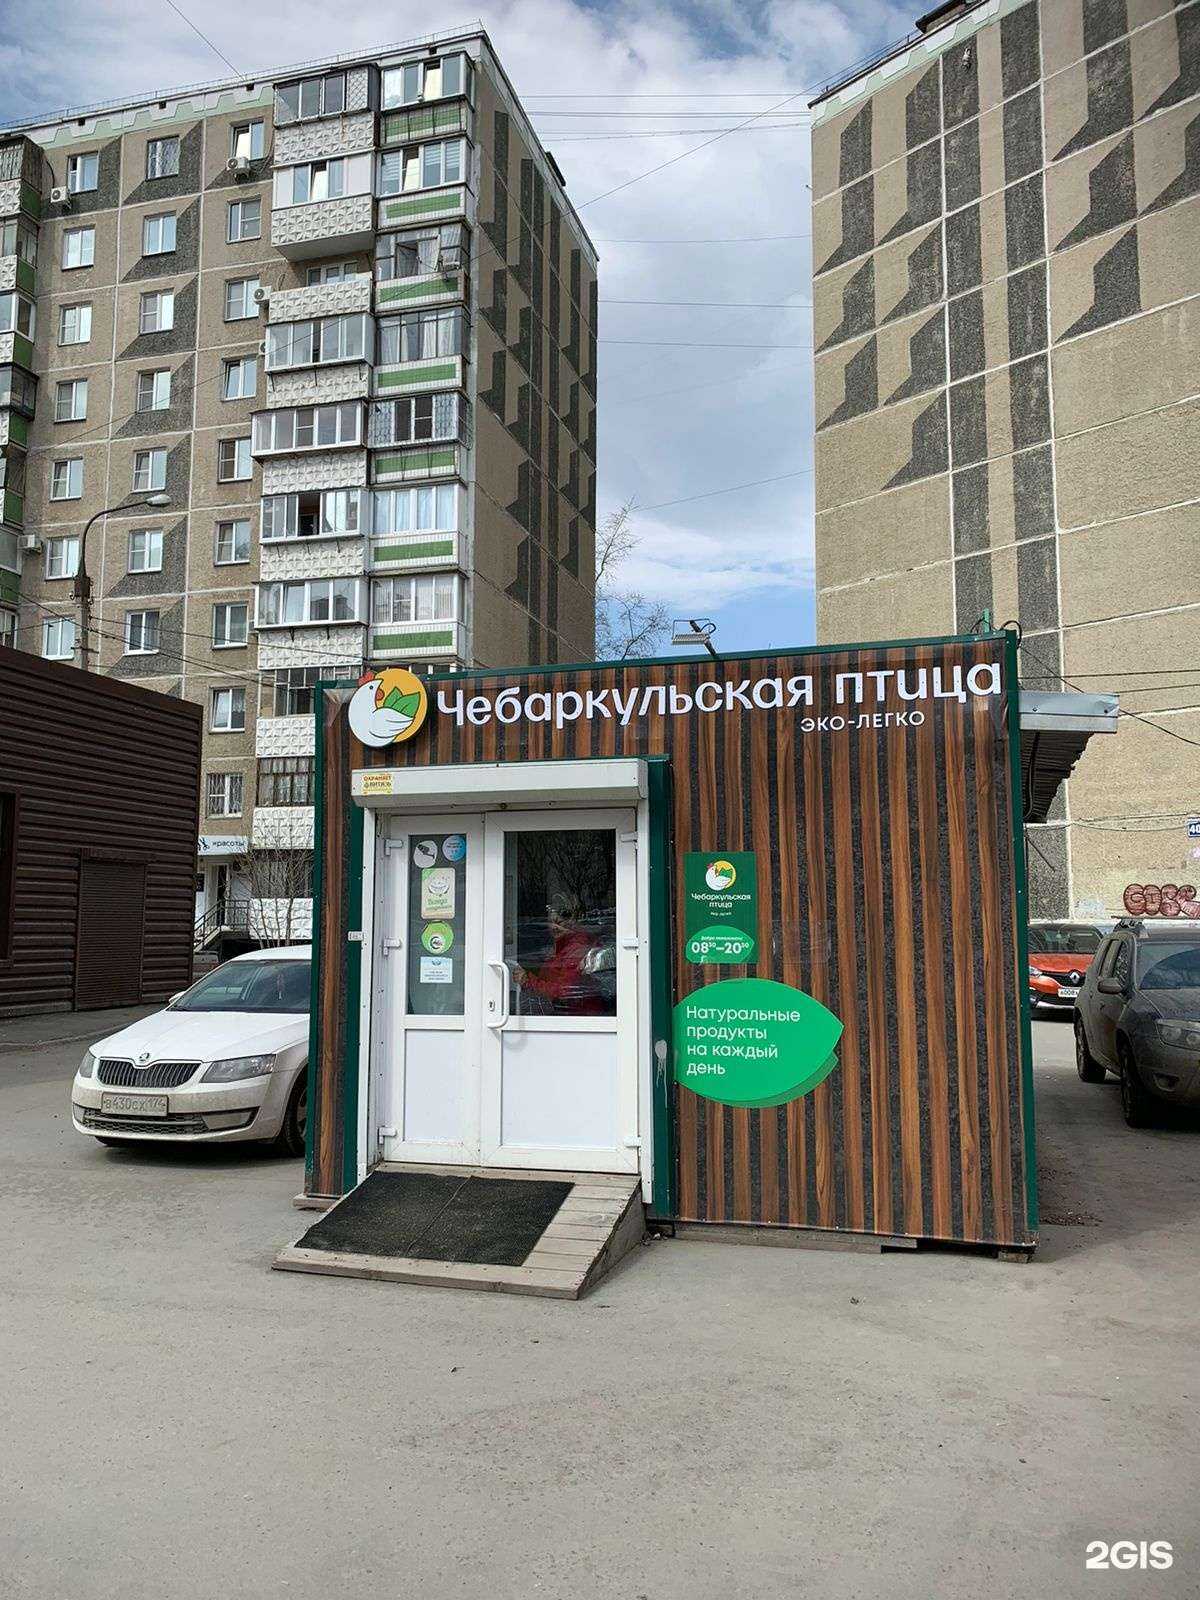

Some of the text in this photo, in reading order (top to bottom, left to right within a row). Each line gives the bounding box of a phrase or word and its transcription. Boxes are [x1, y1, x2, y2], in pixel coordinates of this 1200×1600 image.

[437, 663, 1001, 729] Чебаркульская птица
[800, 710, 925, 732] ЭКО-ЛЕГКО
[690, 892, 752, 901] Чебаркульская
[686, 1005, 801, 1023] Натуральные
[686, 1026, 768, 1041] продукты
[686, 1043, 778, 1060] на каждый
[686, 1062, 726, 1076] день
